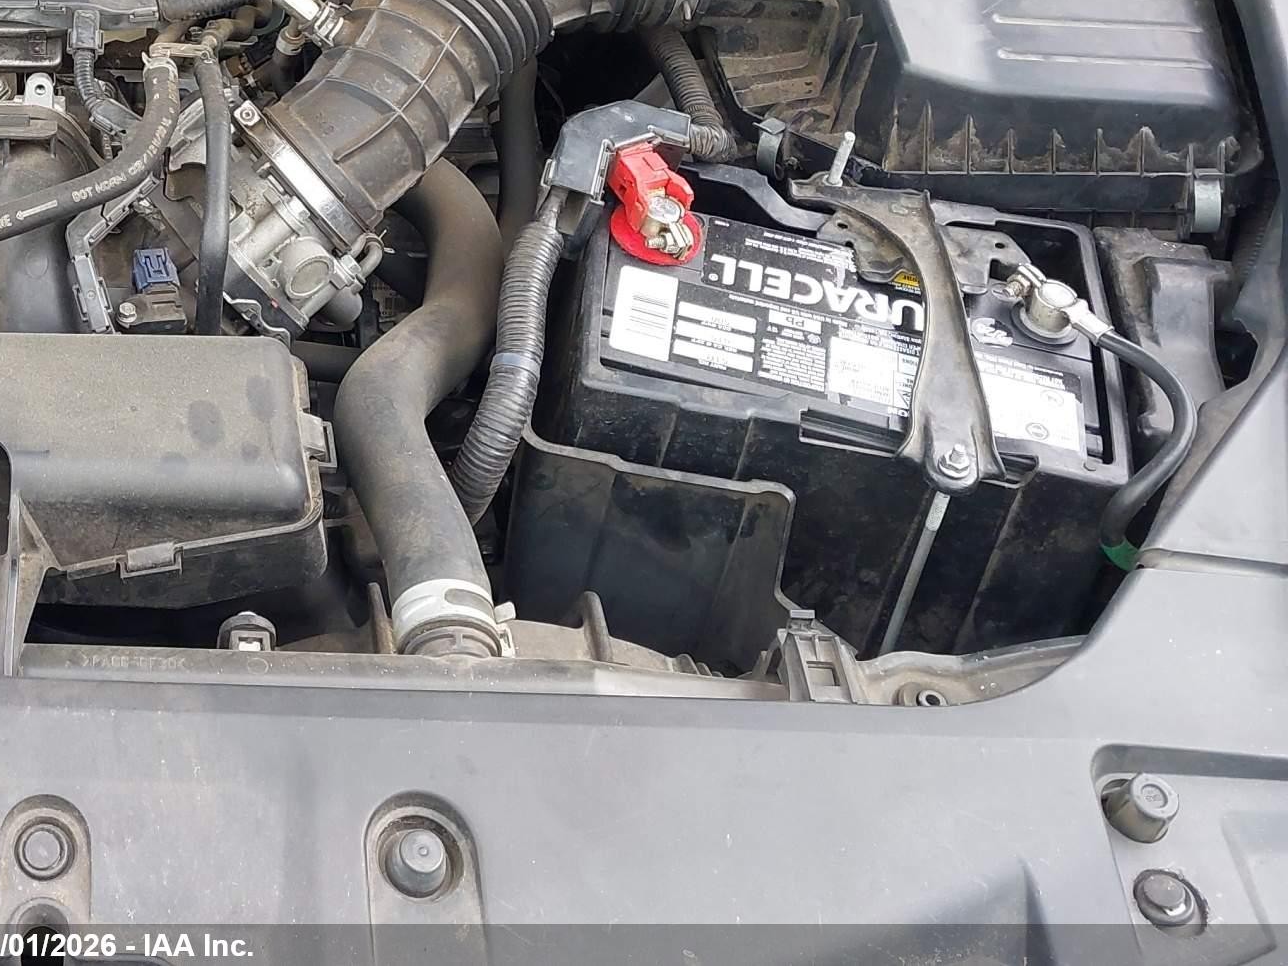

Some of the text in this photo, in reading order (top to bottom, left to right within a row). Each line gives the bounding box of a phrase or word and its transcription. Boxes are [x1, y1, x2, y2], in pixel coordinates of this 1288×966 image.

[71, 186, 94, 203] DOT
[709, 253, 925, 332] URACELL
[786, 316, 806, 326] Pb
